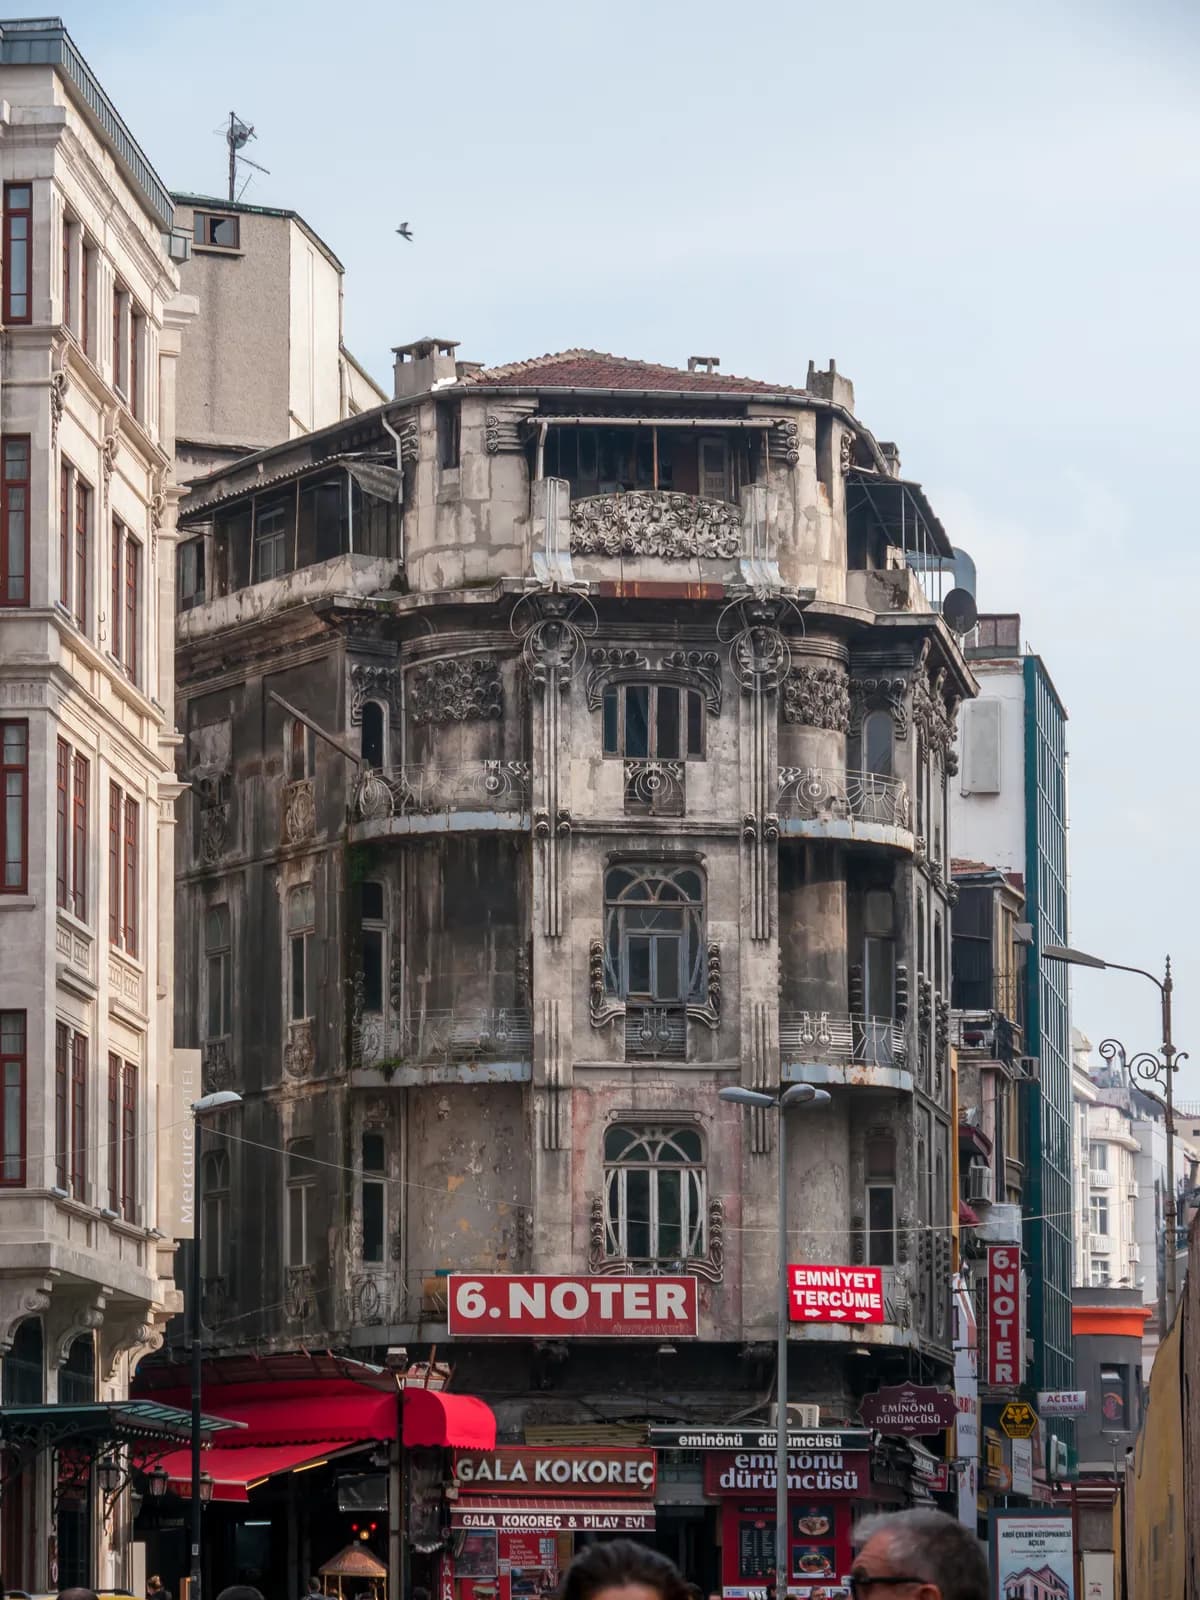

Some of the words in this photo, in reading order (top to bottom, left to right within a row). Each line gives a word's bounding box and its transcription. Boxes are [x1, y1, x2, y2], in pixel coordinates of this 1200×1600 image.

[181, 1127, 193, 1224] Mercure
[794, 1268, 876, 1288] EMNİYET
[508, 1282, 688, 1320] NOTER
[793, 1289, 881, 1309] TERCÜME
[993, 1275, 1015, 1383] NOTER
[881, 1402, 935, 1413] EMİNÖNÜ
[876, 1414, 941, 1424] DÜRÜMCÜSÜ
[678, 1433, 743, 1447] eminönü
[758, 1433, 842, 1448] düümcüsü
[456, 1459, 529, 1482] GALA
[534, 1459, 654, 1490] KOKOREÇ
[462, 1514, 496, 1527] GALA
[502, 1515, 562, 1529] KOKOREÇ
[568, 1516, 577, 1528] &
[583, 1515, 619, 1528] PİLAV
[625, 1516, 646, 1528] EVİ
